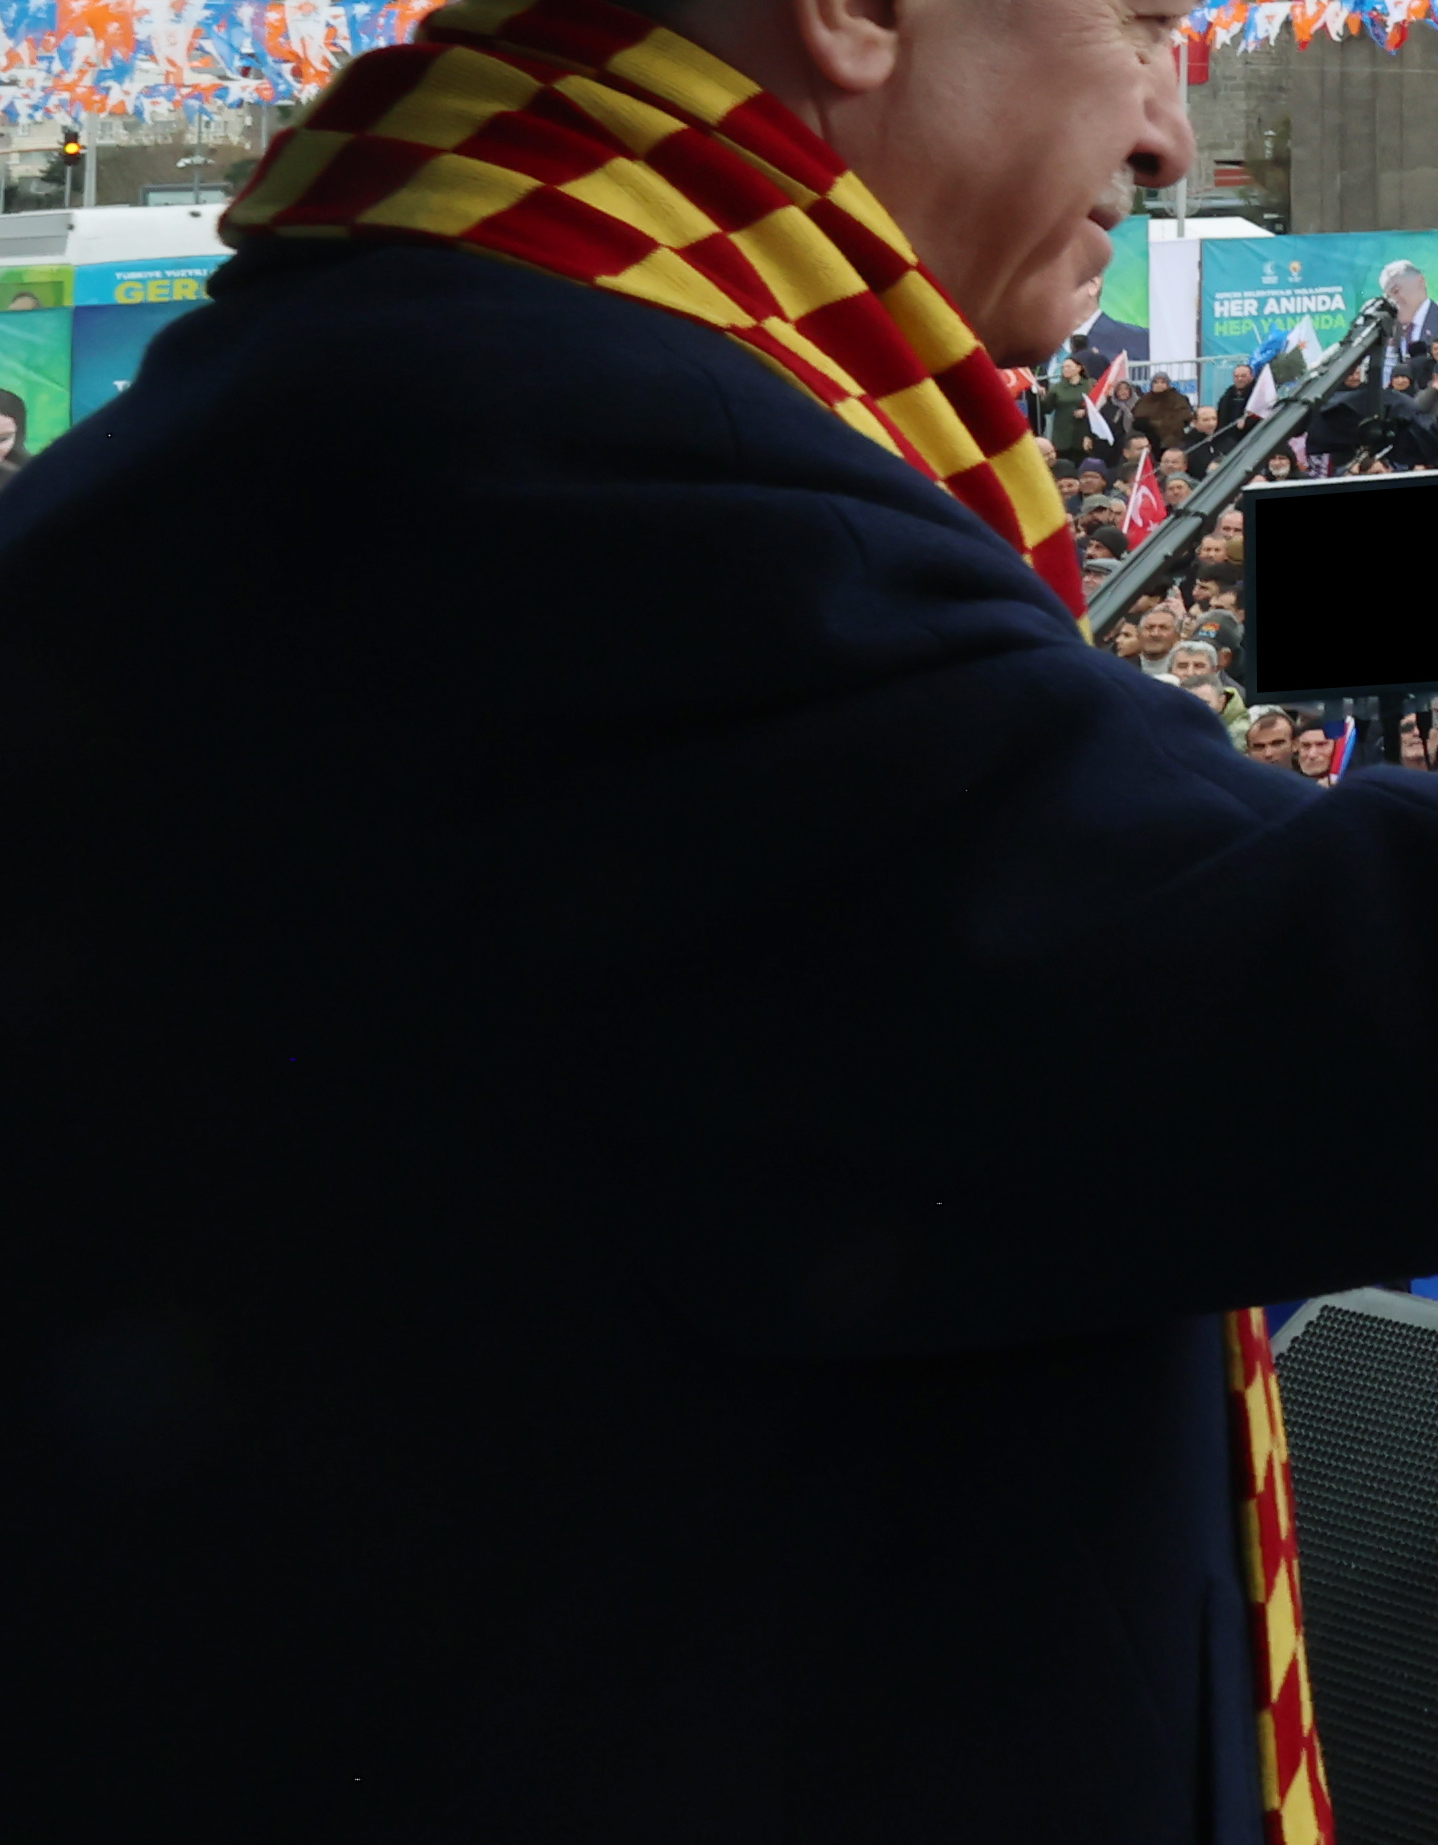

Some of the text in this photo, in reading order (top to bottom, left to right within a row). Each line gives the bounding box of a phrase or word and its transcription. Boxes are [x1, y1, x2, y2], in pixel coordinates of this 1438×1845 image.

[115, 278, 213, 304] GER
[1214, 294, 1346, 318] HER ANINDA
[1214, 314, 1347, 336] HEP YANNDA
